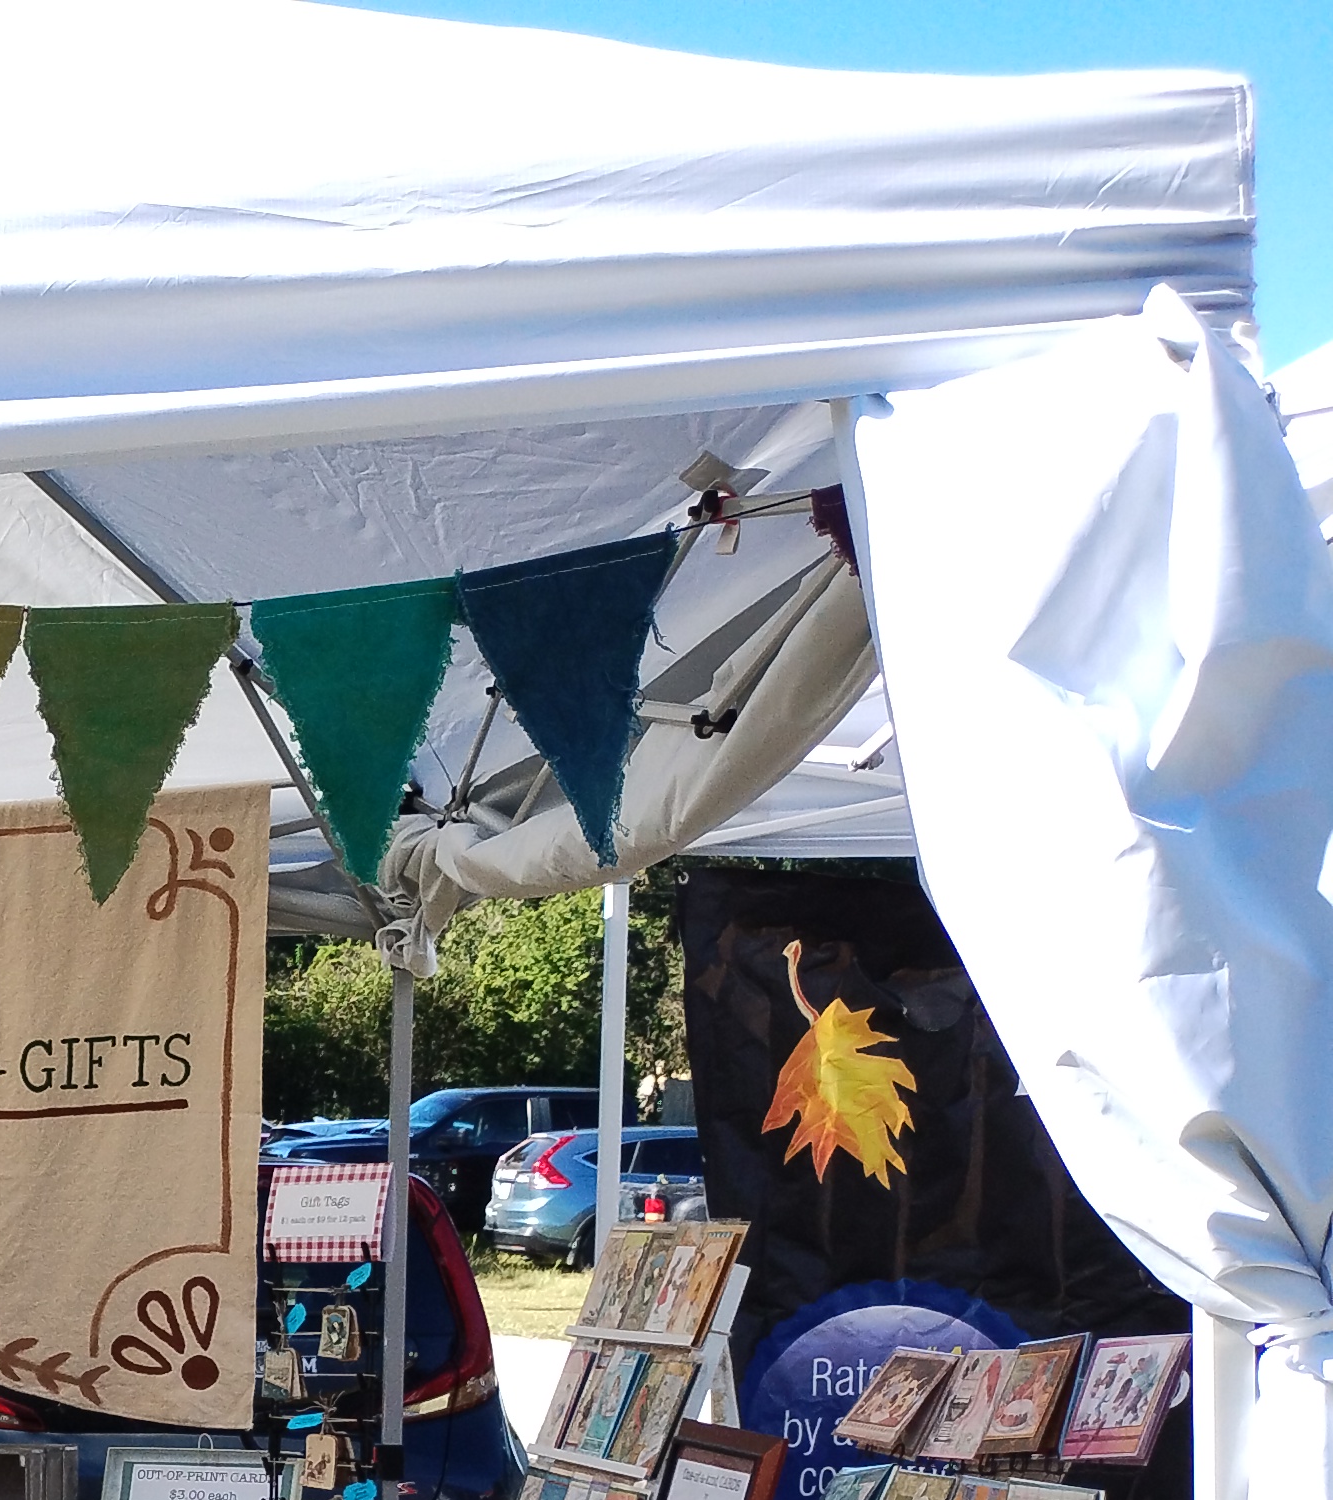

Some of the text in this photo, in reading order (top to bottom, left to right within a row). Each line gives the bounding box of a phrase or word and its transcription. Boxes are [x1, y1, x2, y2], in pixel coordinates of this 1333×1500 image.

[300, 1195, 351, 1209] Gift Tags
[812, 1357, 881, 1397] Rat
[784, 1410, 822, 1455] by
[137, 1469, 272, 1484] OUT-OF-PRINT CARD
[169, 1489, 206, 1500] $3.00
